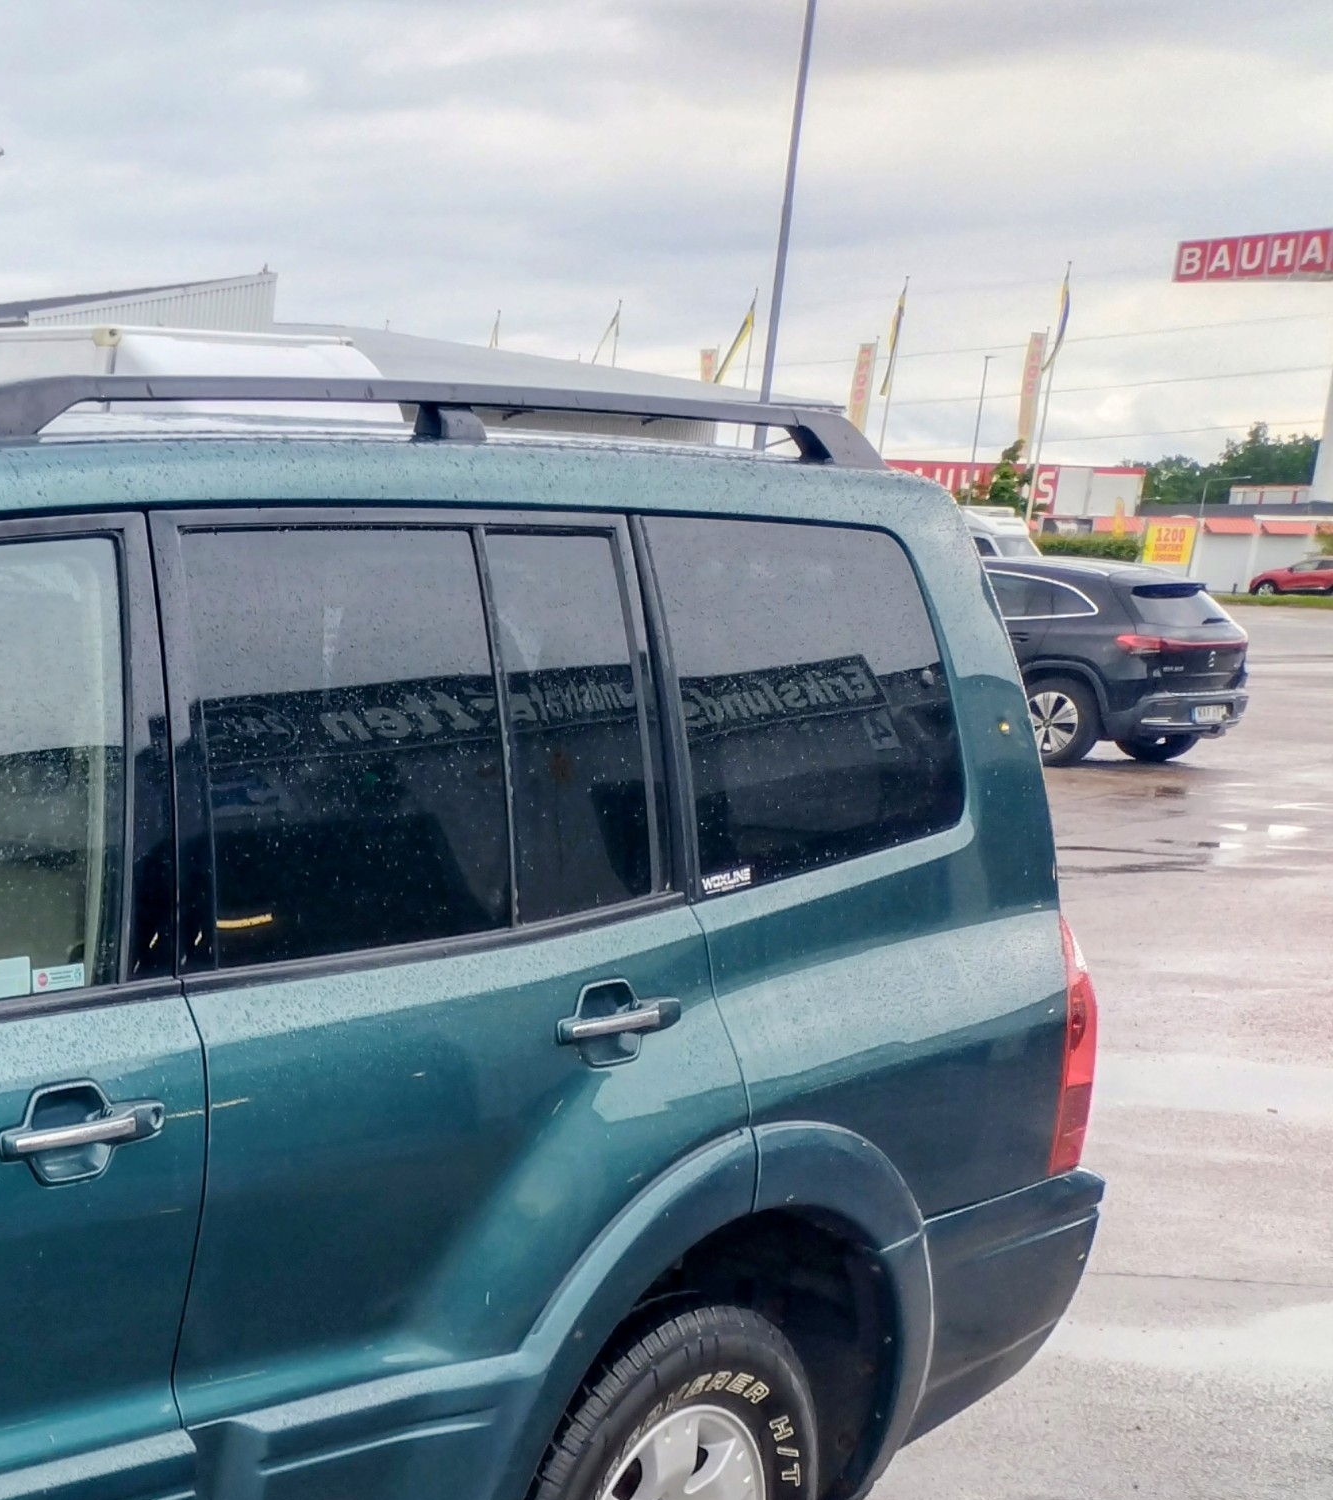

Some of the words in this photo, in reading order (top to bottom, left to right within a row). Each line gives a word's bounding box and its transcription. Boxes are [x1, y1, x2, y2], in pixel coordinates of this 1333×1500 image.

[1155, 527, 1186, 542] 1200
[701, 867, 751, 891] WOXLINE
[768, 1415, 801, 1487] H/T
